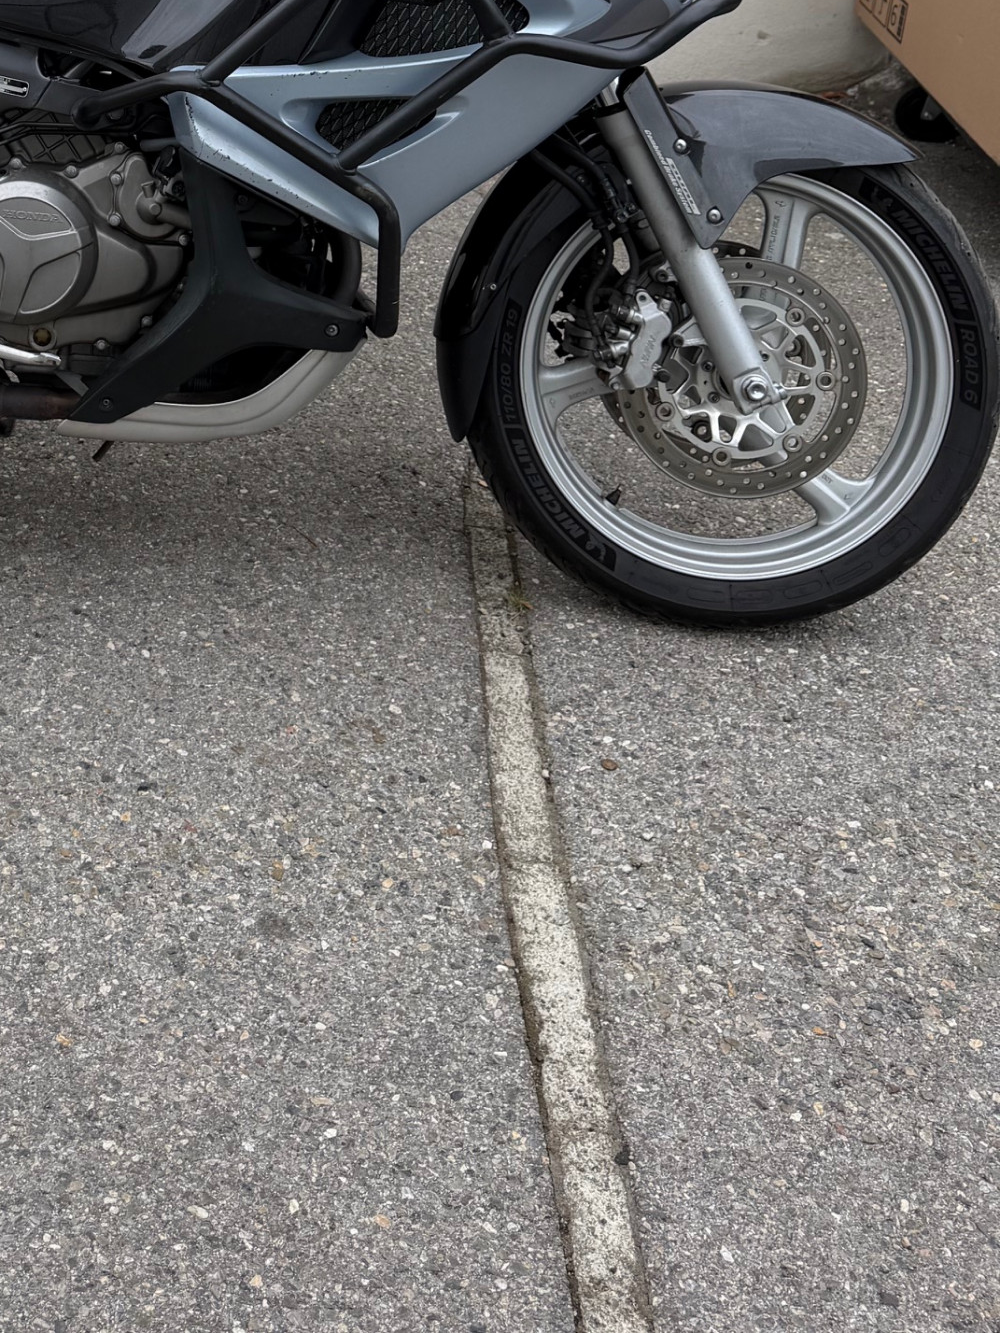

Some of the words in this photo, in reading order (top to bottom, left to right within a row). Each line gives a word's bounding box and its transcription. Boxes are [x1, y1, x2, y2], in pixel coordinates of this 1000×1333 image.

[2, 209, 64, 224] HONDA
[889, 204, 968, 313] MICHELIN
[503, 307, 521, 327] 19
[498, 331, 515, 355] ZR
[959, 326, 980, 383] ROAD
[499, 362, 517, 422] 110/80
[961, 388, 979, 403] 6
[510, 436, 587, 540] MICHELIN
